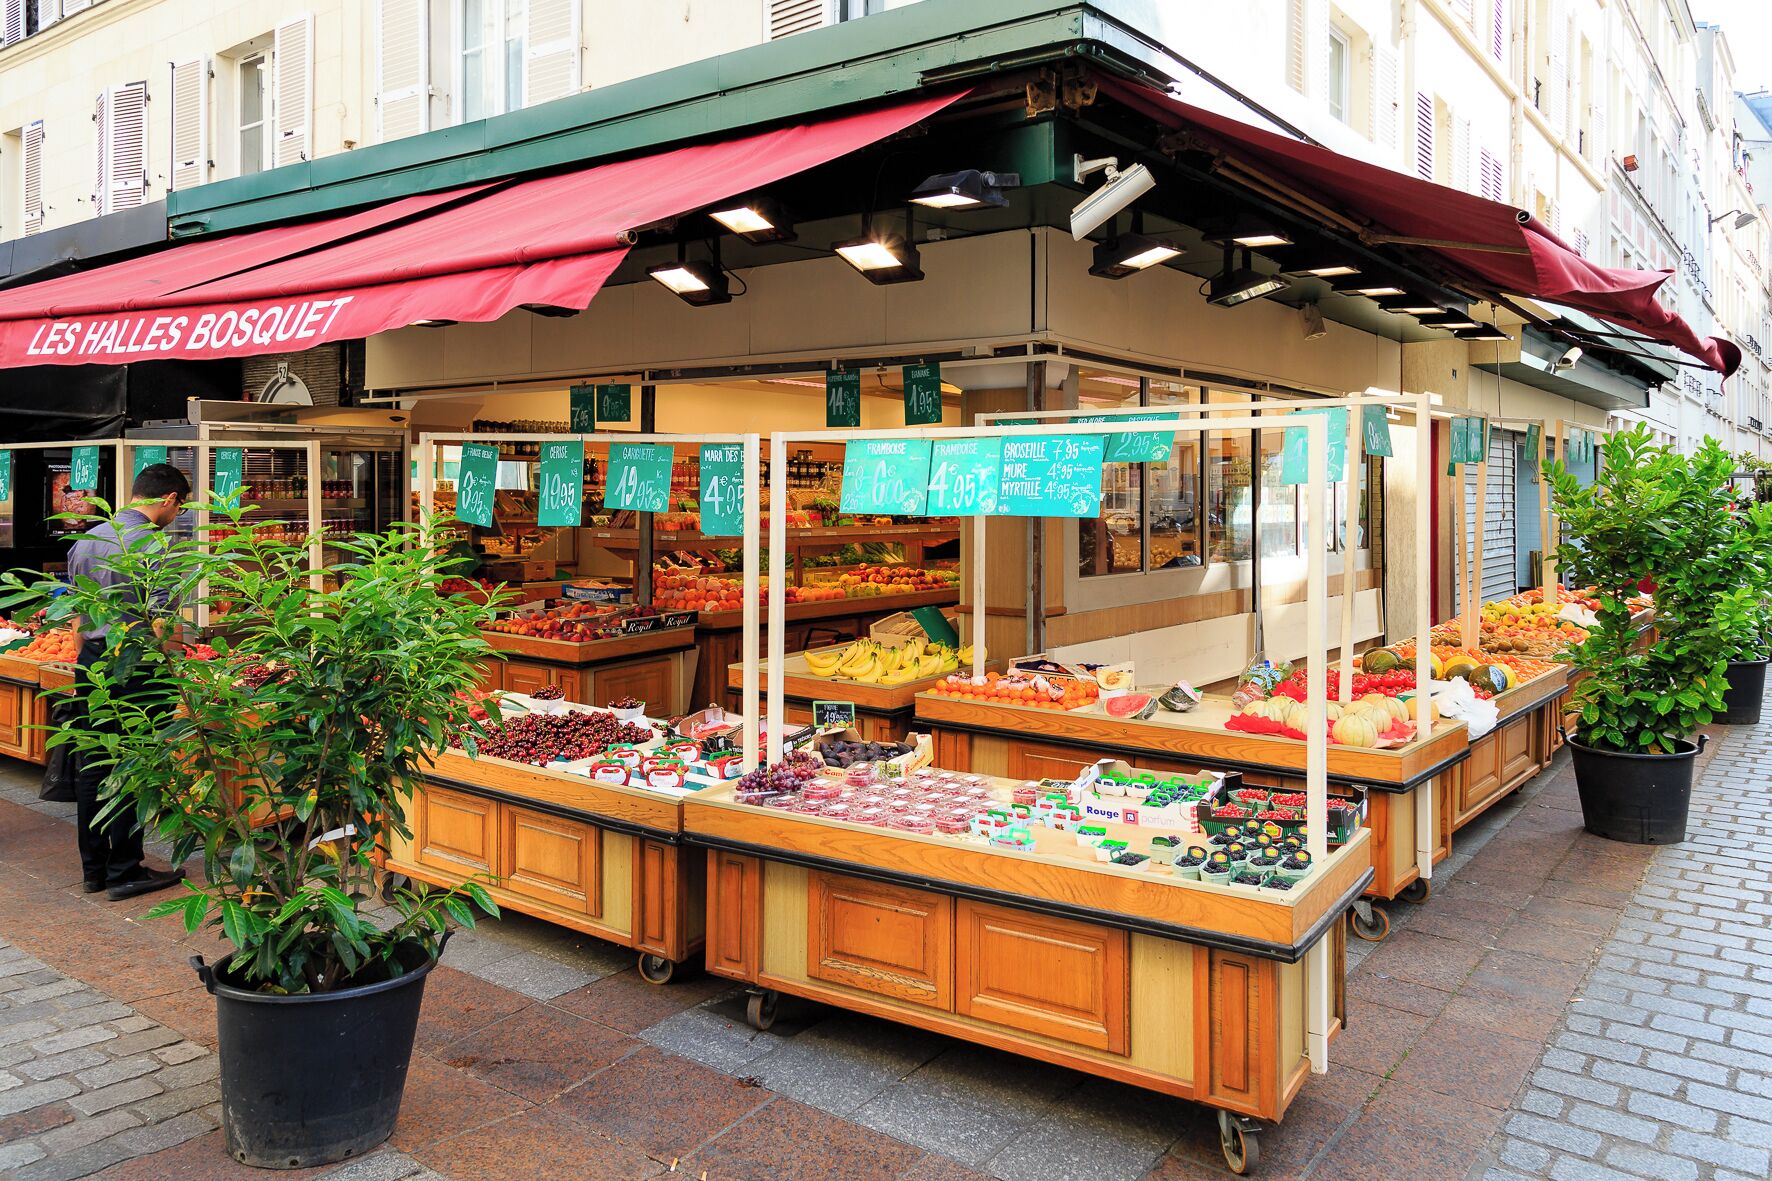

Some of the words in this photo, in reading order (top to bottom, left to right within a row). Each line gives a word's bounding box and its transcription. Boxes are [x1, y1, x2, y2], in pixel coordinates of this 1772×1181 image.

[27, 322, 81, 356] LES
[78, 317, 183, 355] HALLES
[185, 296, 354, 350] BOSQUET
[279, 366, 286, 379] 52
[550, 446, 568, 459] CERISE
[867, 442, 907, 455] FRAMBOISE
[935, 442, 979, 456] FRAMBOISE
[1004, 441, 1047, 459] GROSEILLE
[704, 450, 723, 463] MARA
[725, 450, 739, 463] DES
[1003, 462, 1028, 479] MURE
[1001, 480, 1042, 497] MYRTILLE
[627, 620, 655, 633] Royal
[666, 615, 692, 627] Royal
[1086, 806, 1119, 819] Rouge
